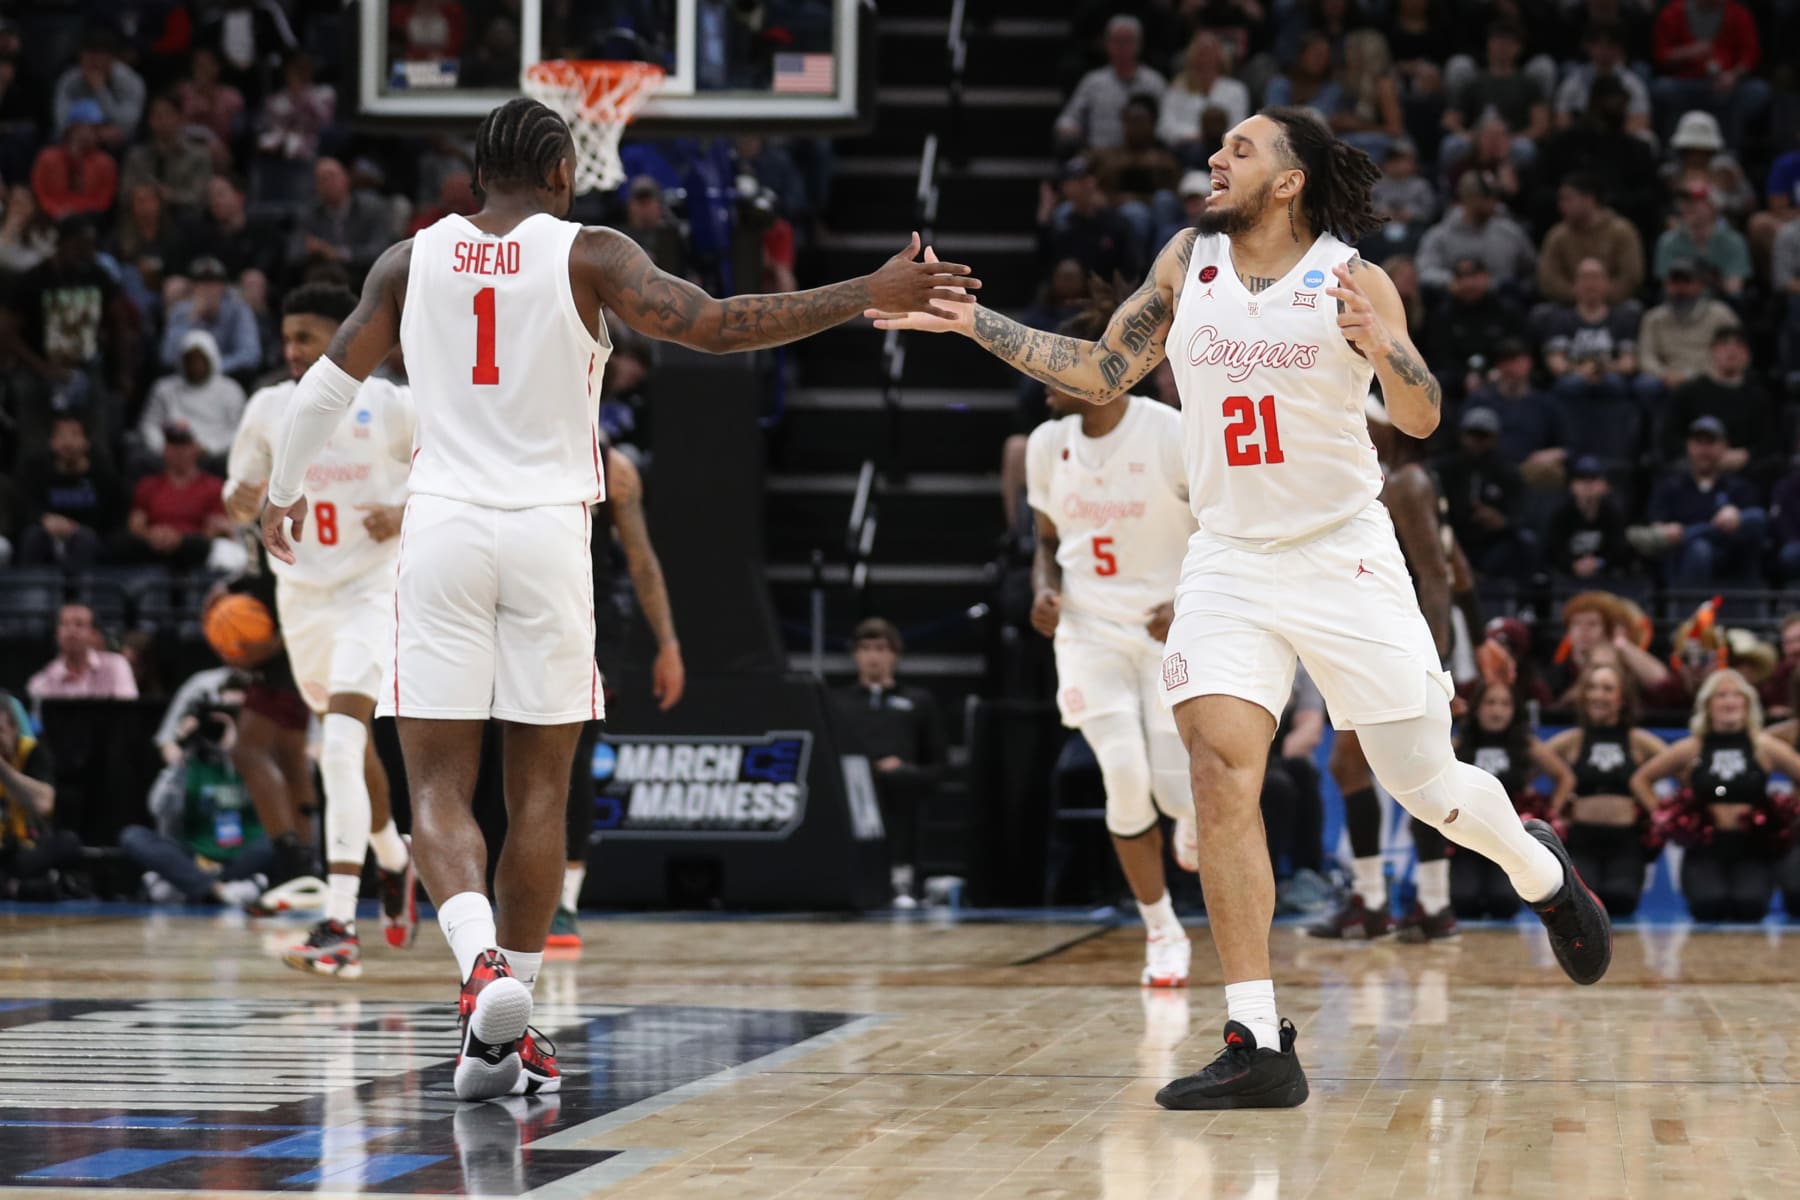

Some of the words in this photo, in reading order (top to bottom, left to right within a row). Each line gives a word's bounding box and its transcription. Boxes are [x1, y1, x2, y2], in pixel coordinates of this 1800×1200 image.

[453, 241, 520, 275] SHEAD
[472, 287, 500, 385] 1
[1187, 325, 1319, 382] Cougars
[1222, 395, 1285, 467] 21
[314, 501, 339, 546] 8
[1092, 536, 1118, 577] 5
[615, 744, 744, 782] MARCH
[627, 782, 801, 823] MADNESS
